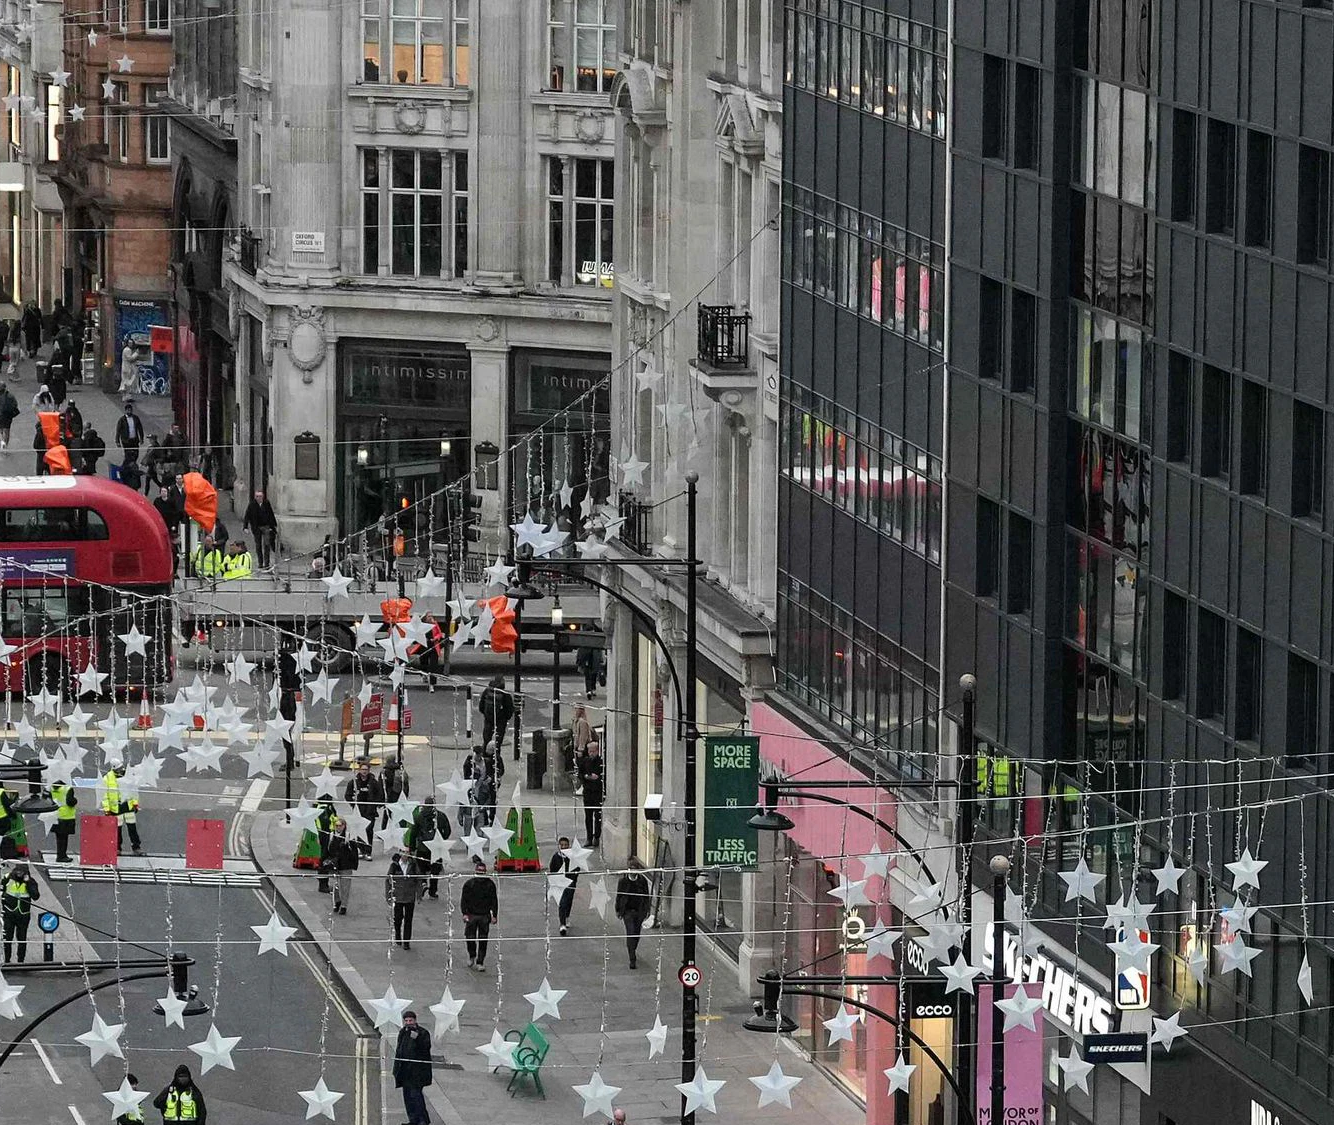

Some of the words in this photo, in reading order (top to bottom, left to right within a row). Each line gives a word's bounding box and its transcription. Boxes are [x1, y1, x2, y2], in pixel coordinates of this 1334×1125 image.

[713, 745, 752, 757] MORE
[713, 757, 752, 769] SPACE
[717, 838, 746, 850] LESS
[705, 850, 758, 863] TRAFFIC
[684, 972, 699, 982] 20
[982, 921, 1114, 1036] SKCHERS
[916, 1004, 953, 1017] ecco
[1088, 1044, 1144, 1053] SKECHERS
[979, 1107, 1027, 1119] MYOR
[1027, 1107, 1039, 1115] OF
